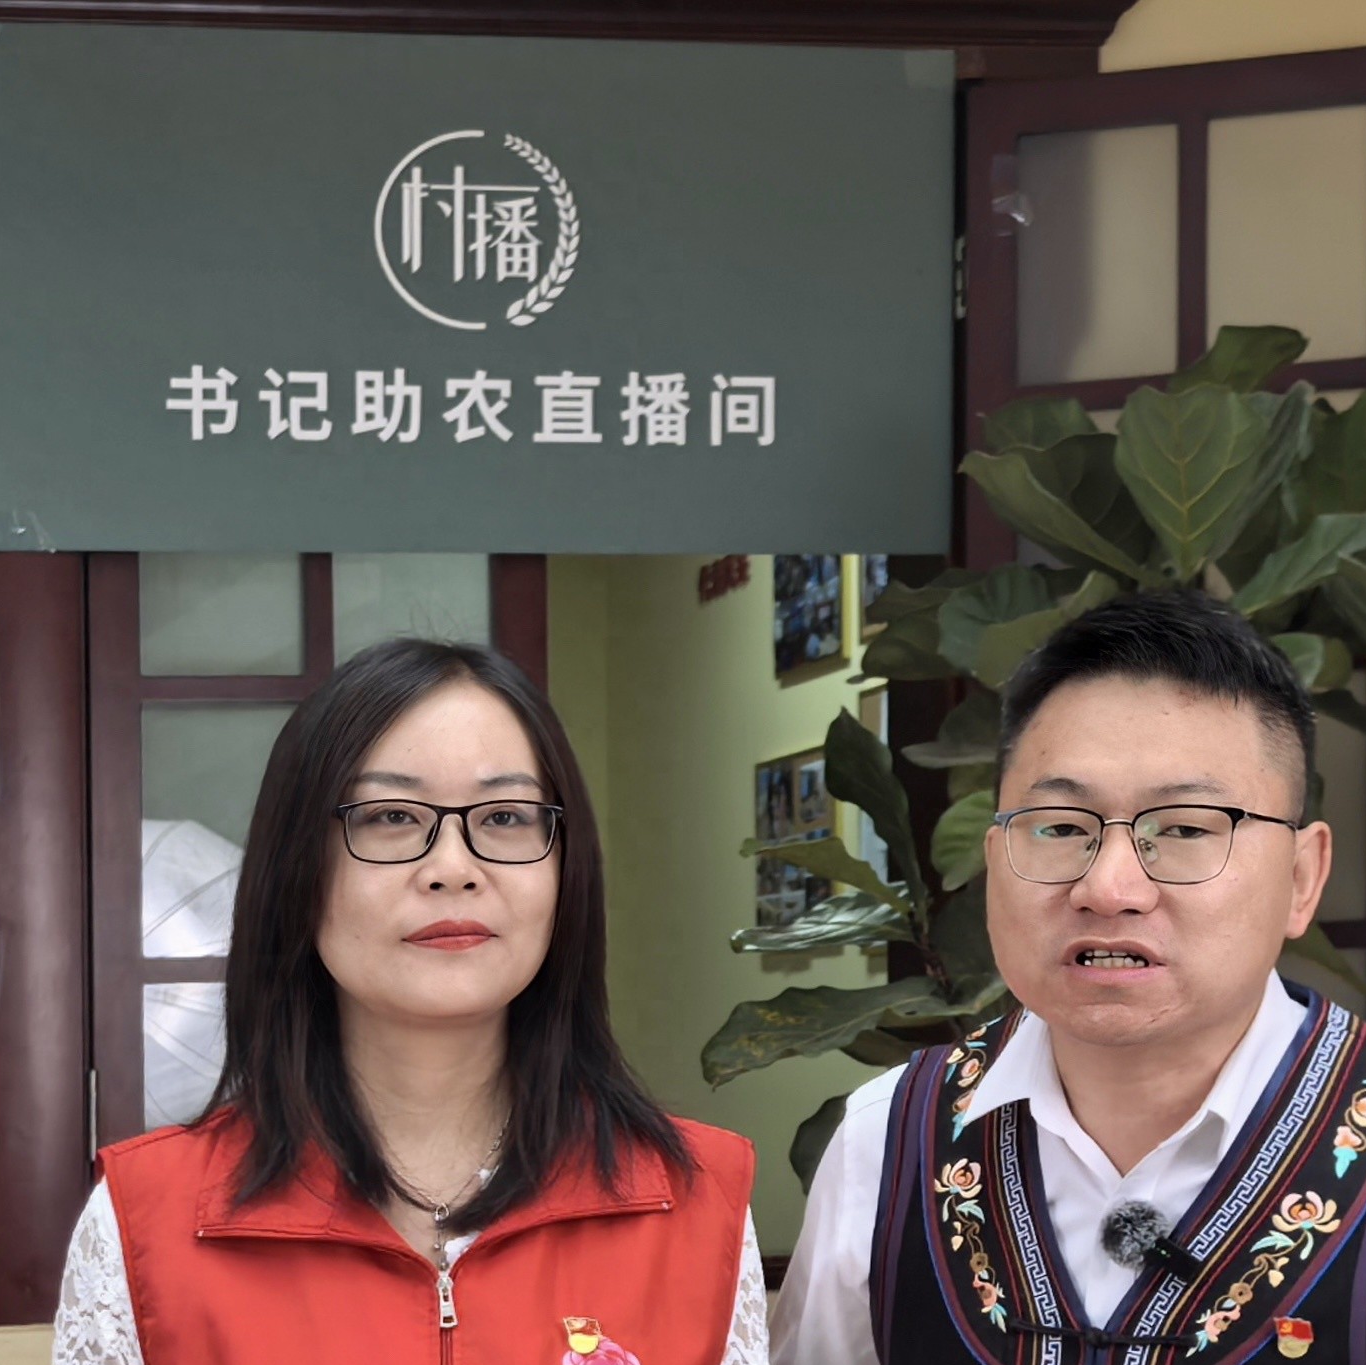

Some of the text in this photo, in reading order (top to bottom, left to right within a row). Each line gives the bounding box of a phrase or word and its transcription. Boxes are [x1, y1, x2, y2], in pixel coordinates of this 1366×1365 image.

[165, 364, 778, 448] 书记助农直播间
